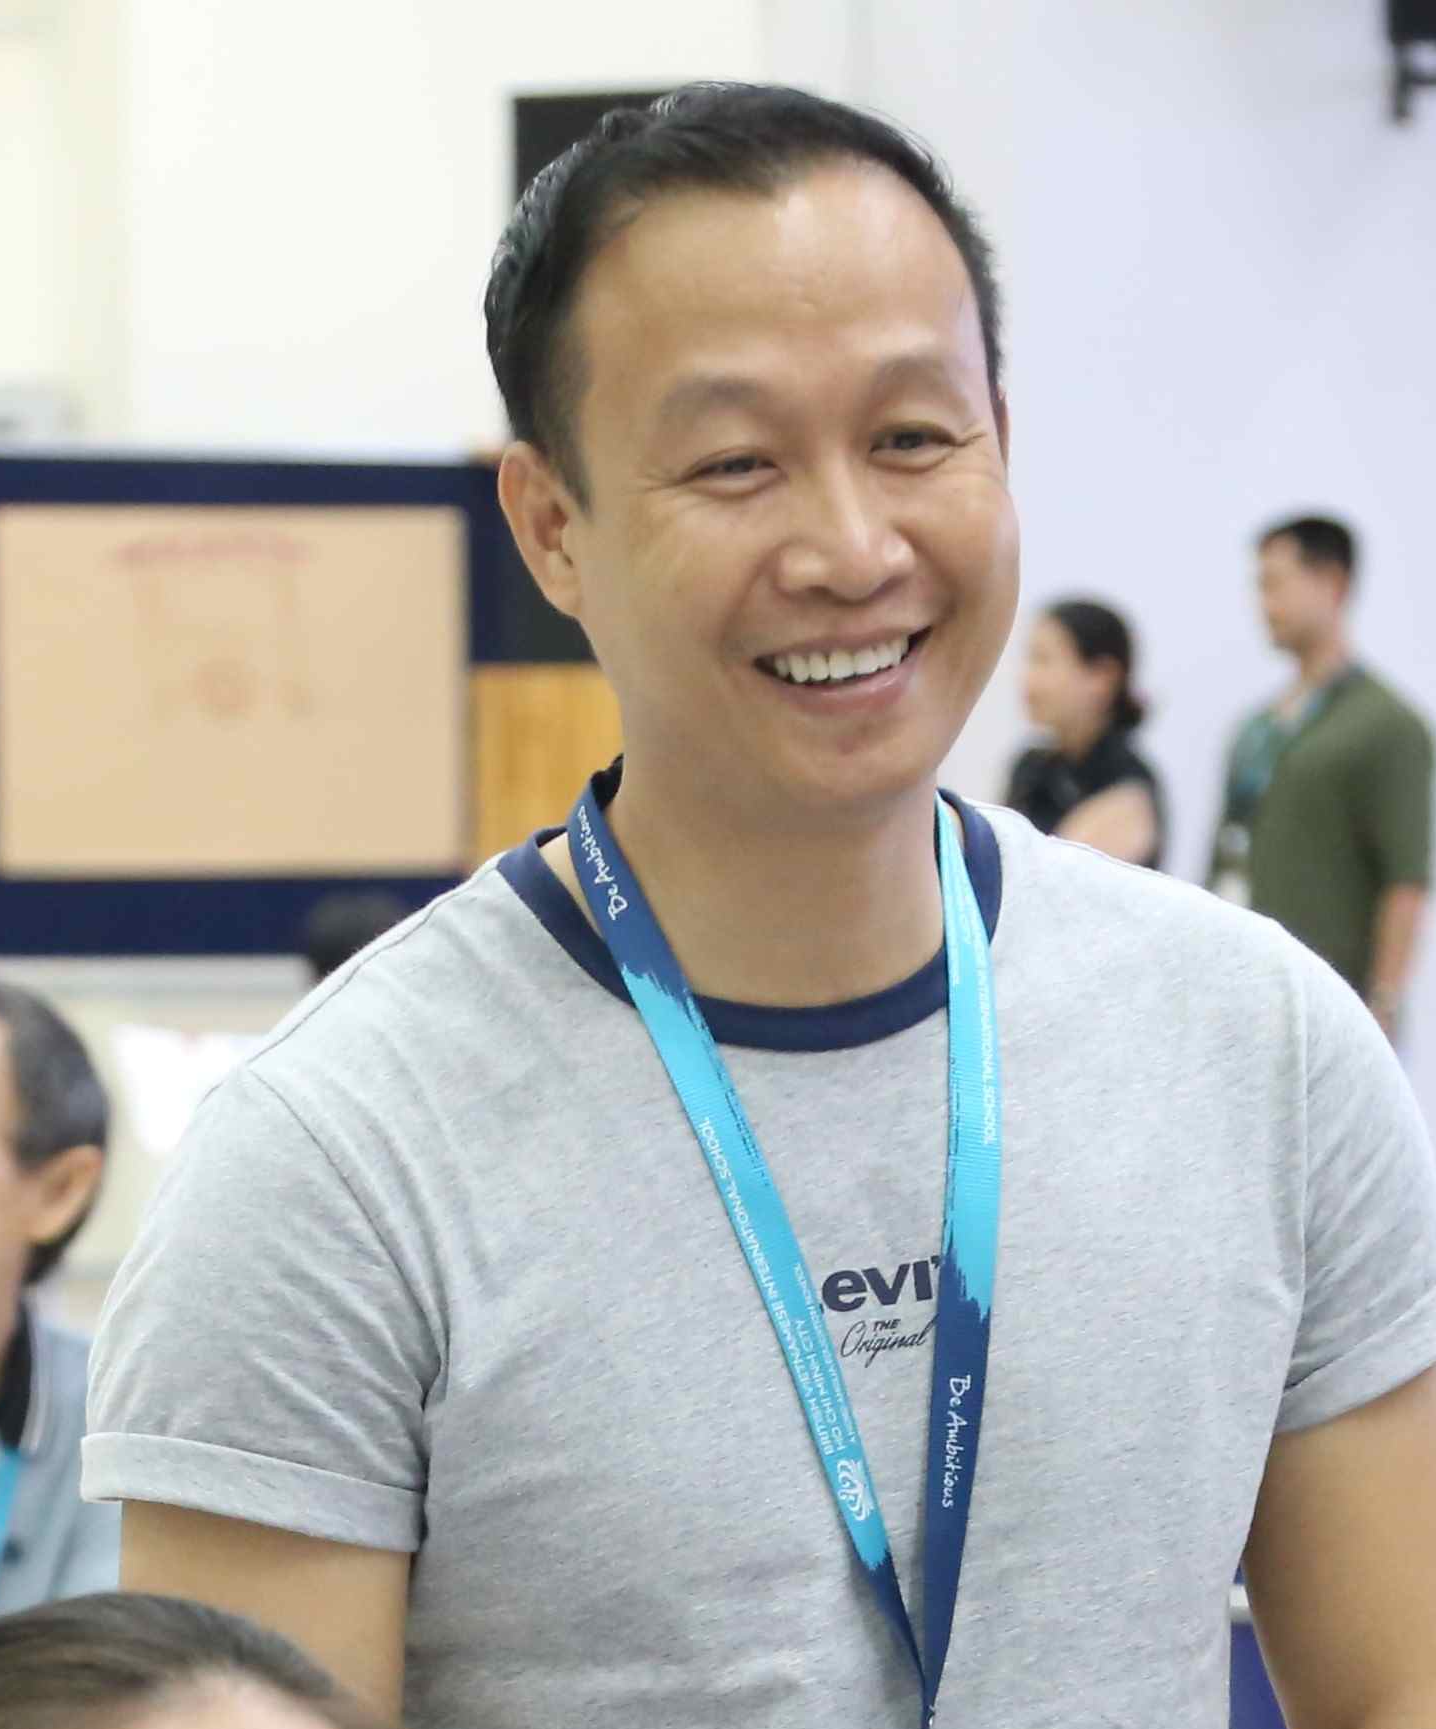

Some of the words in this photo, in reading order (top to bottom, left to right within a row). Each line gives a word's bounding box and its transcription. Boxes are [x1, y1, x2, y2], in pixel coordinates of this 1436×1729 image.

[578, 805, 616, 884] Ambitious
[608, 884, 628, 921] Be
[982, 1083, 998, 1145] SCHOOL
[697, 1116, 733, 1179] SCHOOL
[725, 1182, 779, 1298] INTERNATIONAL
[795, 1319, 815, 1352] CITY
[840, 1314, 940, 1369] Original
[873, 1318, 901, 1332] THE
[949, 1374, 971, 1408] Be
[941, 1410, 968, 1509] Ambitious
